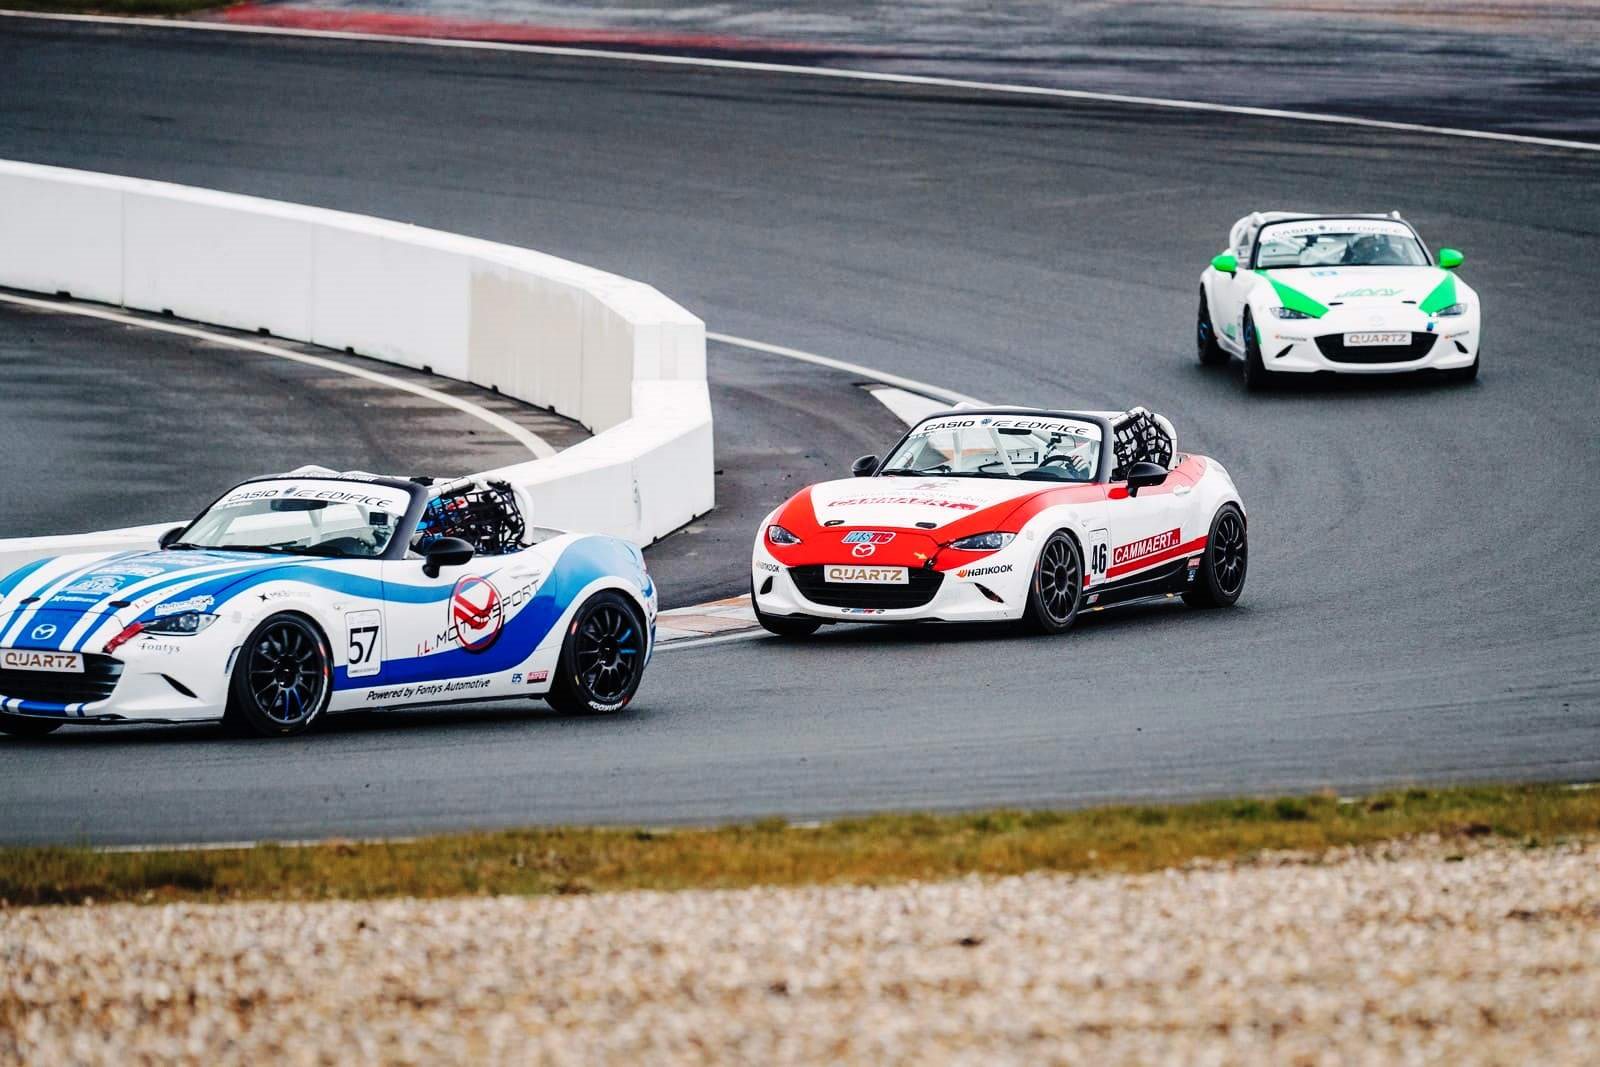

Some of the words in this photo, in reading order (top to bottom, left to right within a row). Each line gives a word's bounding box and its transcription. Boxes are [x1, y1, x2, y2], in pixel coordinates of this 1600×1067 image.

[1349, 333, 1407, 344] QUARTZ
[924, 420, 975, 431] CASIO
[1014, 420, 1089, 435] EDIFICE
[228, 490, 279, 502] CASIO
[317, 490, 393, 508] EDIFICE
[1115, 531, 1174, 563] CAMMAERT
[1091, 543, 1107, 575] 46
[829, 568, 903, 581] QUARTZ
[349, 625, 379, 665] 57
[5, 652, 77, 669] QUARTZ
[366, 688, 403, 701] Powered
[404, 686, 415, 699] by
[415, 683, 443, 696] Fontys
[443, 678, 491, 692] Automotive
